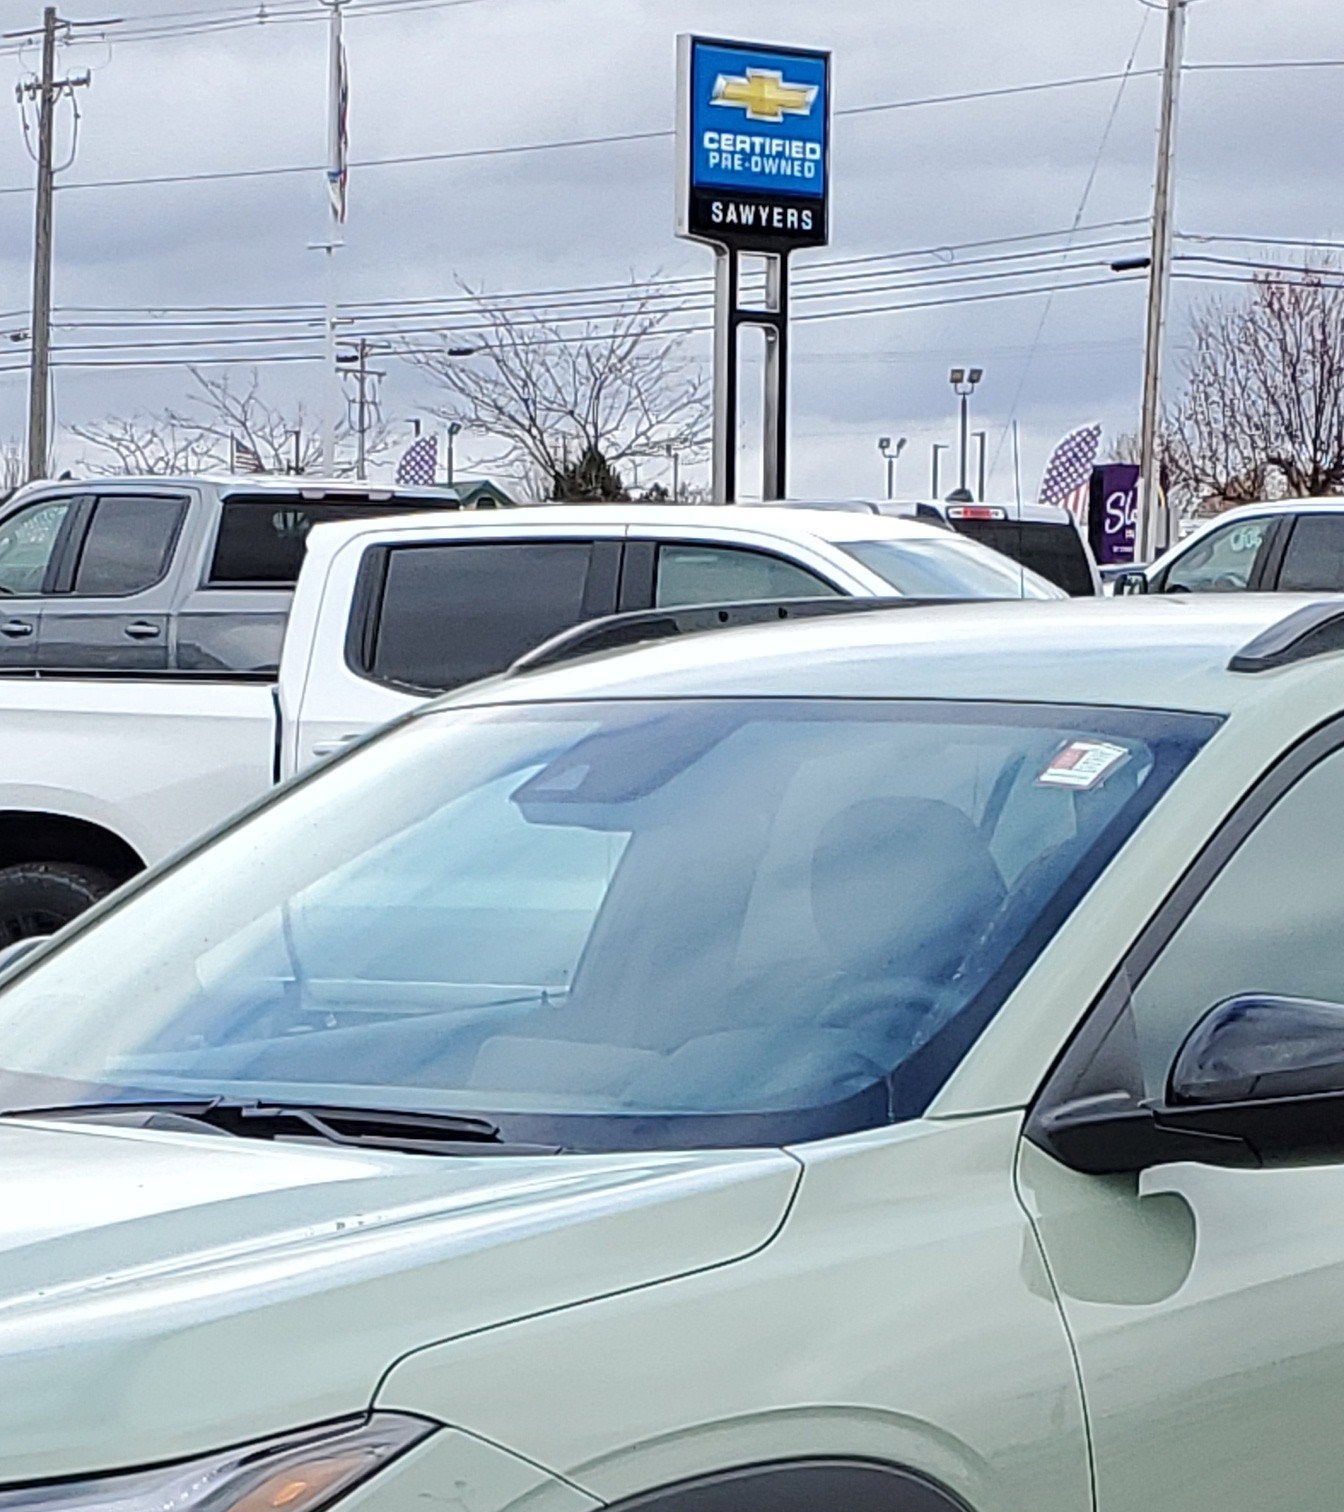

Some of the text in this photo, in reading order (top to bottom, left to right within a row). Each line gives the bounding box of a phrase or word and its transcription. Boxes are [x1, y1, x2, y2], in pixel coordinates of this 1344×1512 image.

[703, 130, 821, 160] CERTIFIED
[709, 151, 816, 179] PRE-OWNED
[711, 201, 813, 230] SAWYERS
